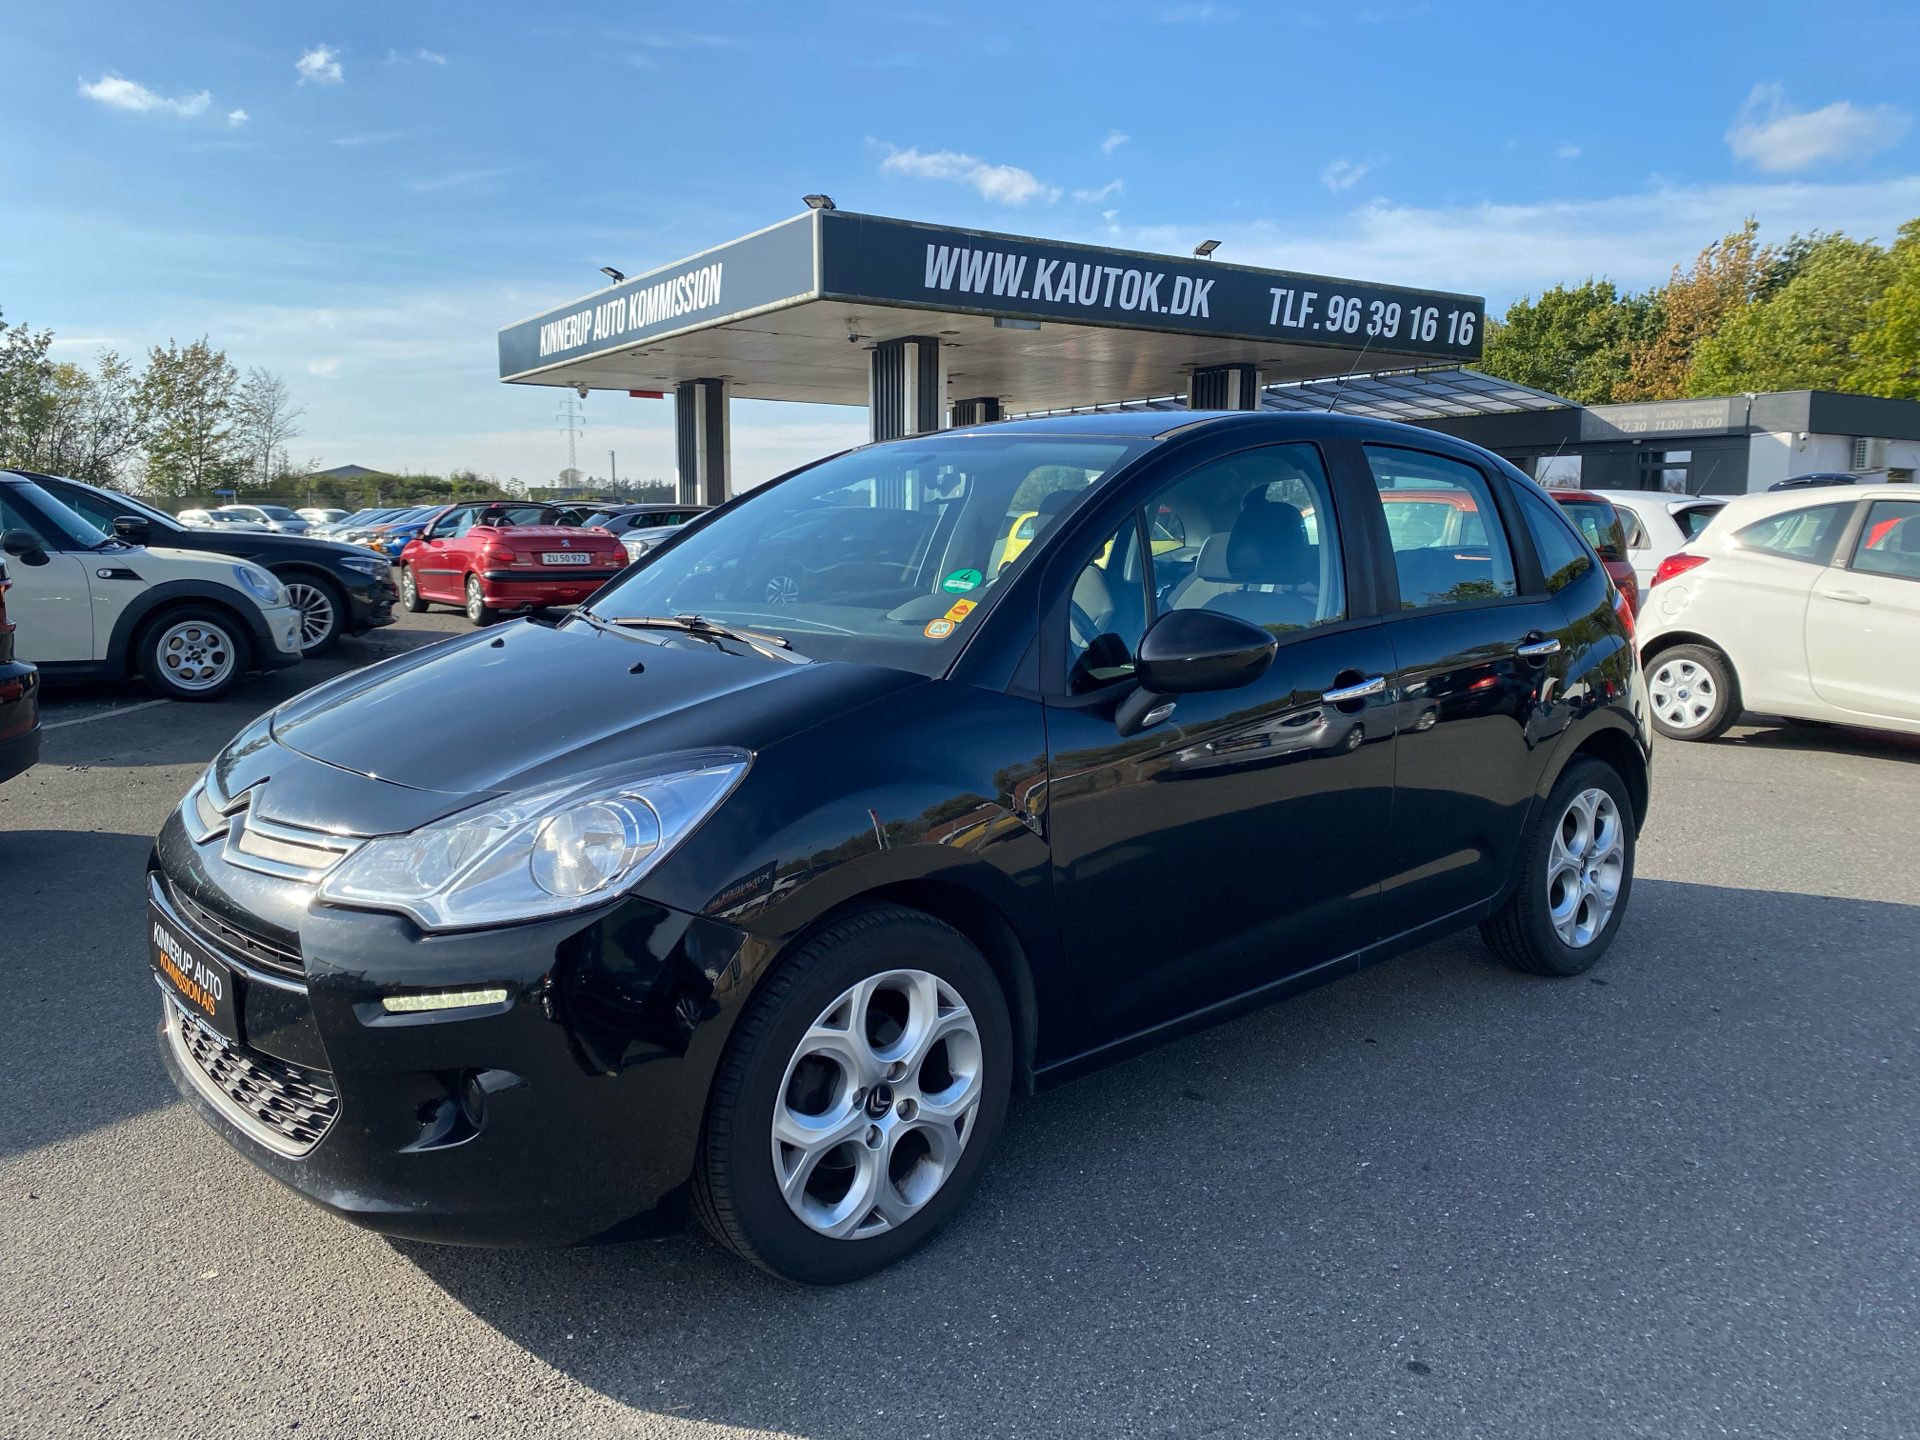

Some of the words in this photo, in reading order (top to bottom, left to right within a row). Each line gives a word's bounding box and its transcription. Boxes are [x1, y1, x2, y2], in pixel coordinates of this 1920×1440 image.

[540, 309, 593, 357] KINNERUP
[593, 297, 626, 341] AUTO
[628, 262, 723, 331] KOMMISSION
[924, 244, 1216, 318] WWW.KAUTOK.DK
[1269, 287, 1320, 330] TLF.
[1326, 295, 1362, 334] 96
[1366, 301, 1402, 338] 39
[1410, 306, 1439, 342] 16
[1448, 310, 1476, 346] 16
[1618, 421, 1648, 433] 17.30
[1621, 412, 1648, 420] FREDAG
[1655, 419, 1683, 431] 11.00
[1691, 417, 1722, 430] 16.00
[546, 554, 559, 563] ZU
[560, 554, 572, 563] 50
[572, 554, 587, 563] 972
[153, 921, 193, 975] KINNERUP
[194, 961, 222, 1001] AUTO
[160, 950, 201, 1004] KOMMISSION
[201, 991, 216, 1016] A/S
